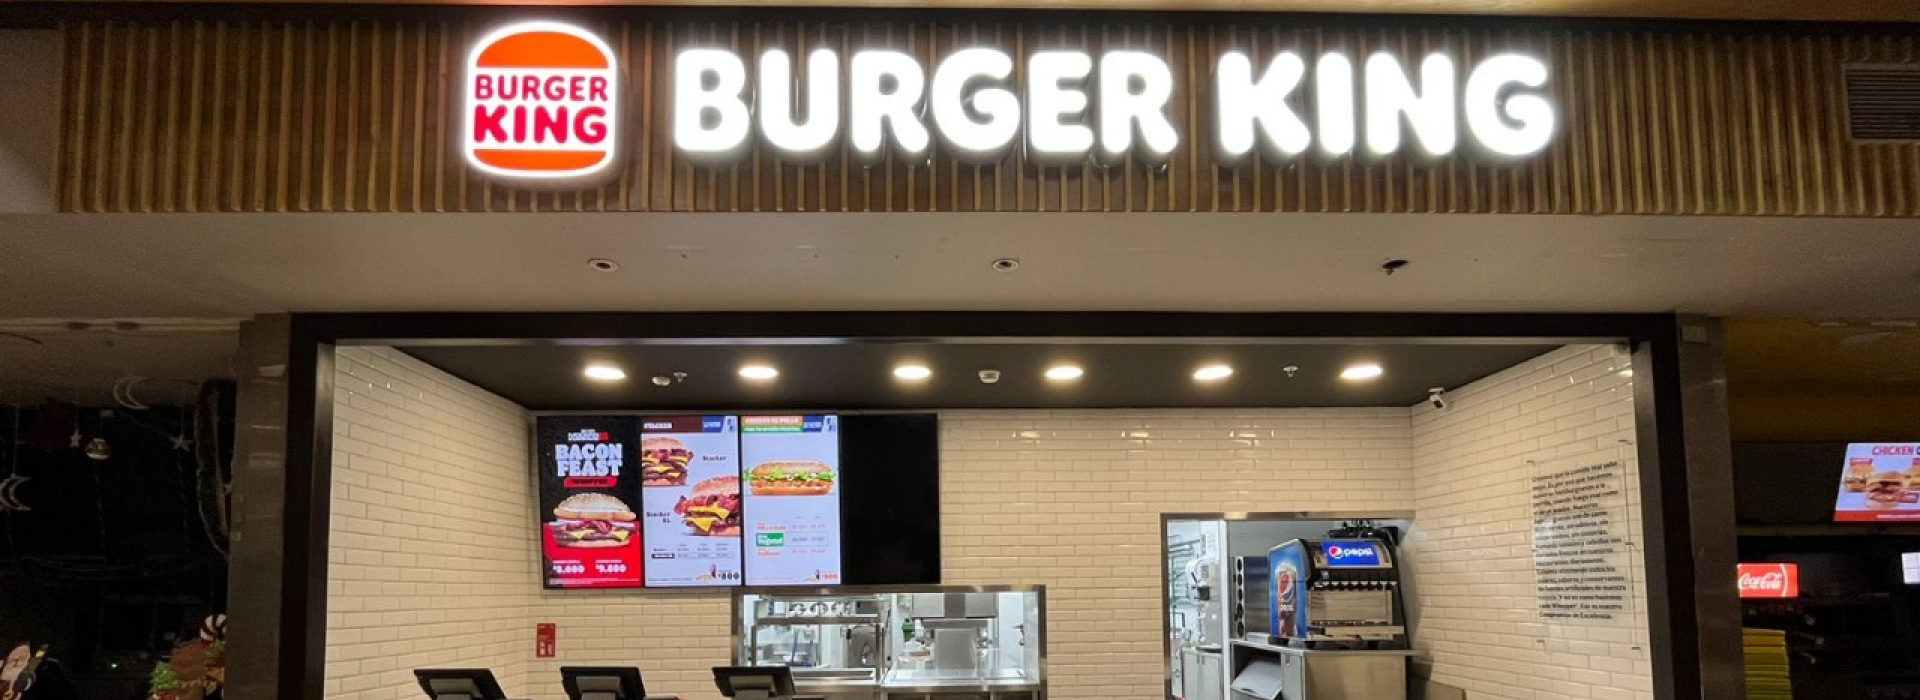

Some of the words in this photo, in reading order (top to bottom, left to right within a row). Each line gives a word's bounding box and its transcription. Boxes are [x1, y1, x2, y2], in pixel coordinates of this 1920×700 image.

[474, 75, 608, 101] BURGER
[674, 47, 1179, 154] BURGER
[1217, 50, 1556, 157] KING
[473, 105, 608, 144] KING
[555, 443, 623, 459] BACON
[1872, 445, 1914, 455] CHICKEN
[557, 460, 623, 477] FEAST
[1343, 547, 1374, 557] pepsi
